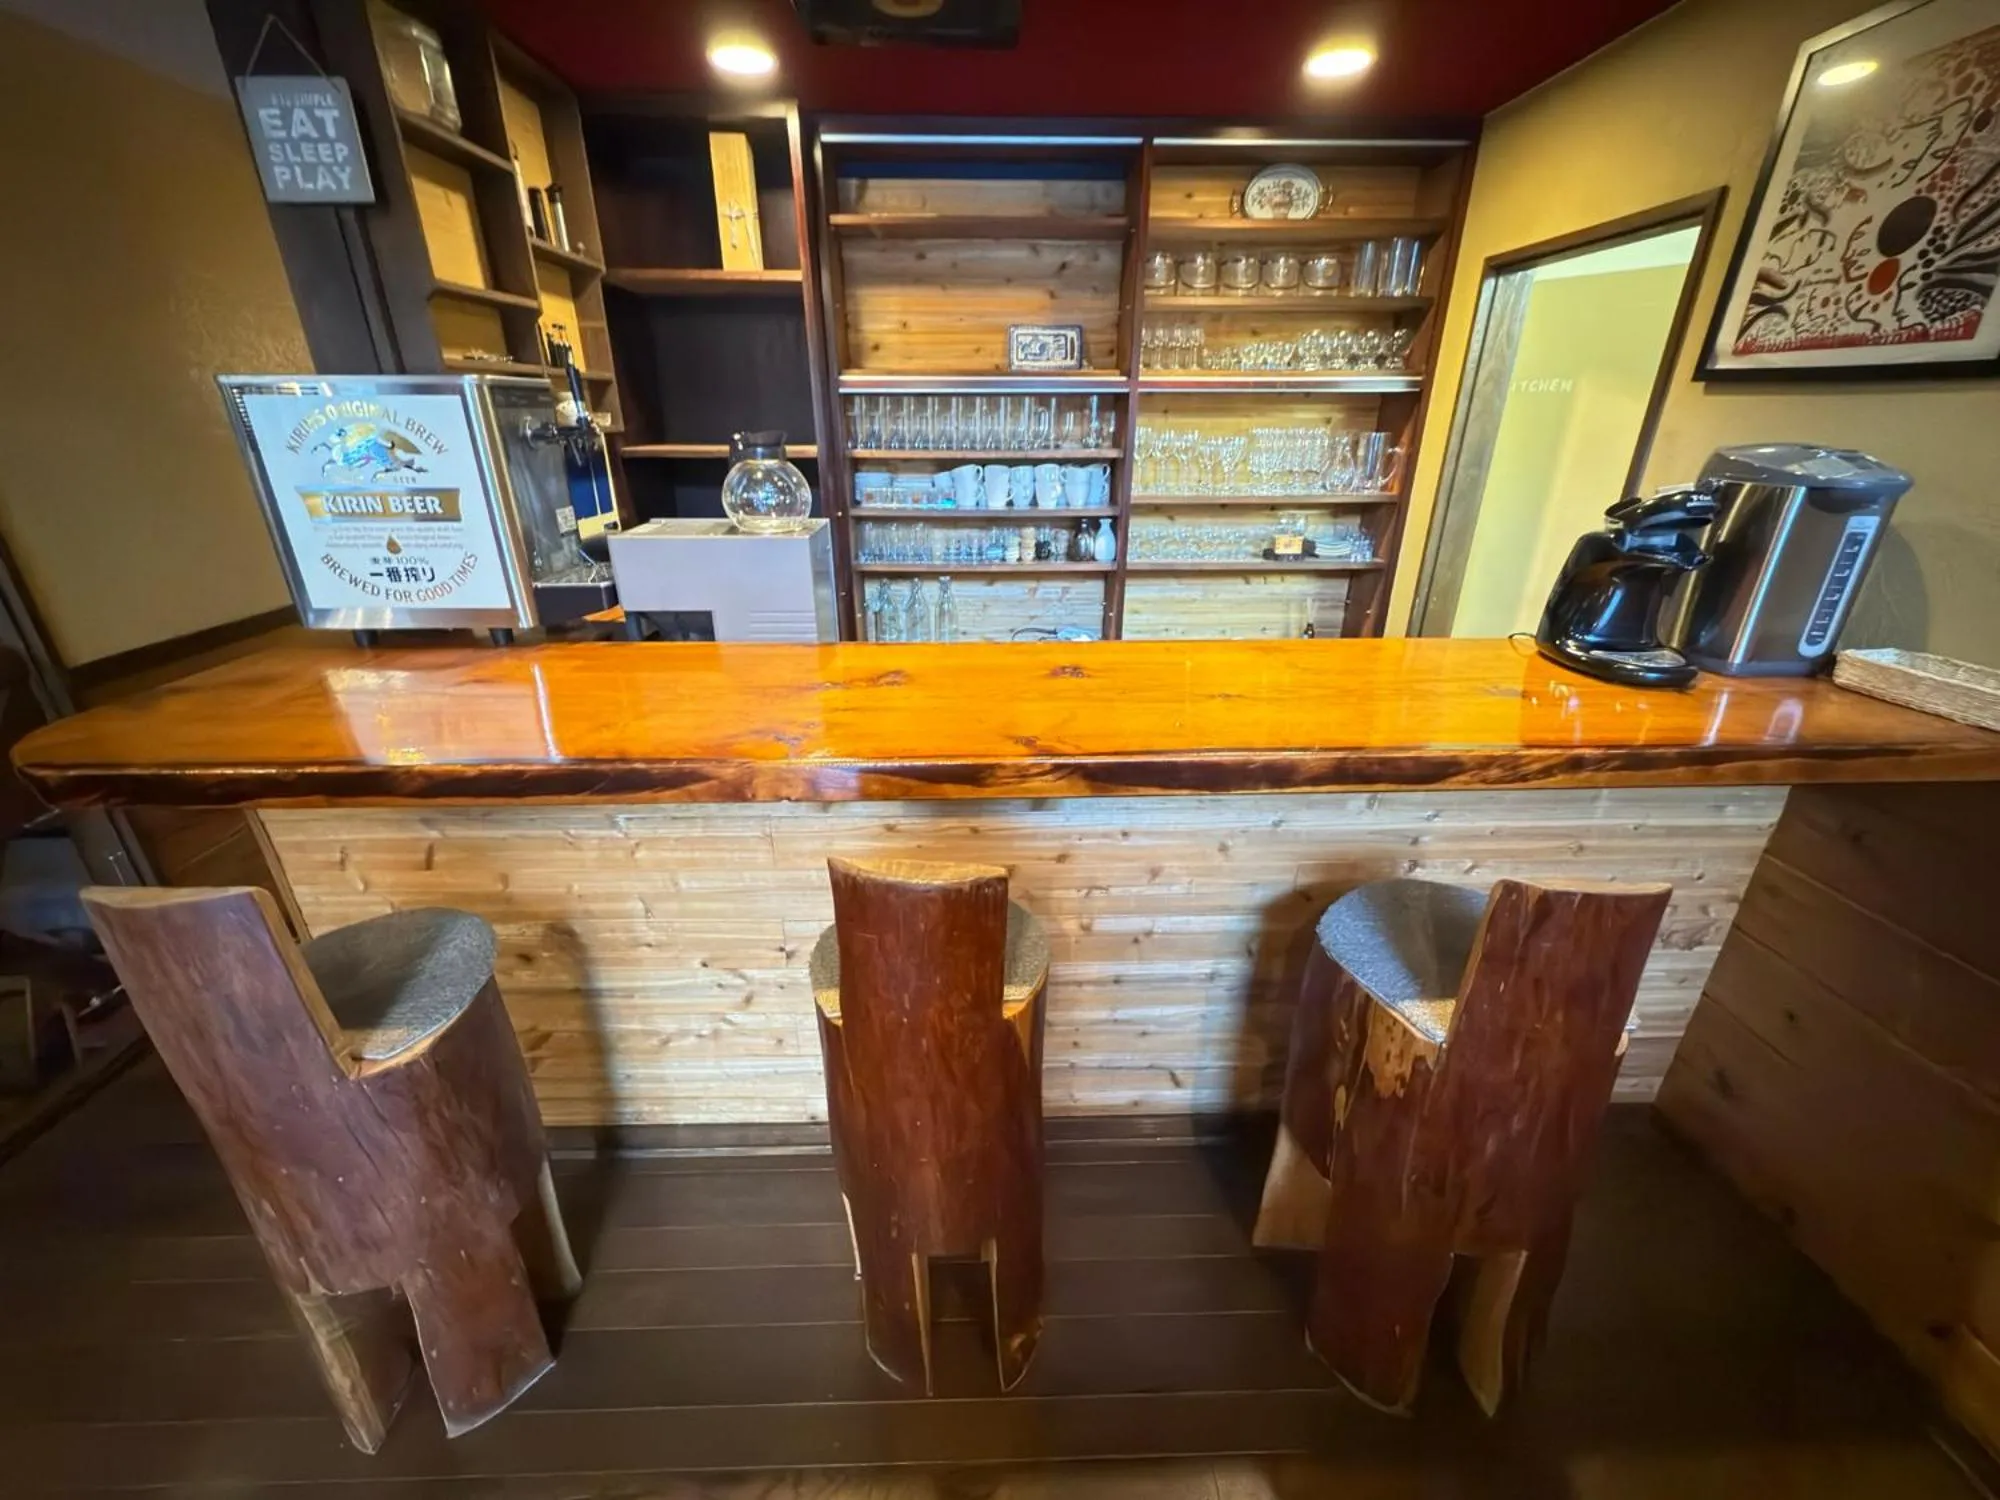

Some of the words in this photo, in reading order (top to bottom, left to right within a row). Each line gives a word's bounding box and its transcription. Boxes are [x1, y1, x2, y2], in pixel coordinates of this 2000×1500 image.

[257, 107, 340, 139] EAT
[268, 142, 349, 164] SLEEP
[273, 165, 352, 191] PLAY
[1509, 377, 1574, 393] ITCHEN
[404, 416, 449, 455] BREW
[322, 494, 385, 514] KIRIN
[388, 495, 444, 515] BEER
[320, 553, 381, 597] BREWED
[385, 588, 413, 603] FOR
[416, 580, 454, 602] GOOD
[450, 551, 478, 587] TIMES
